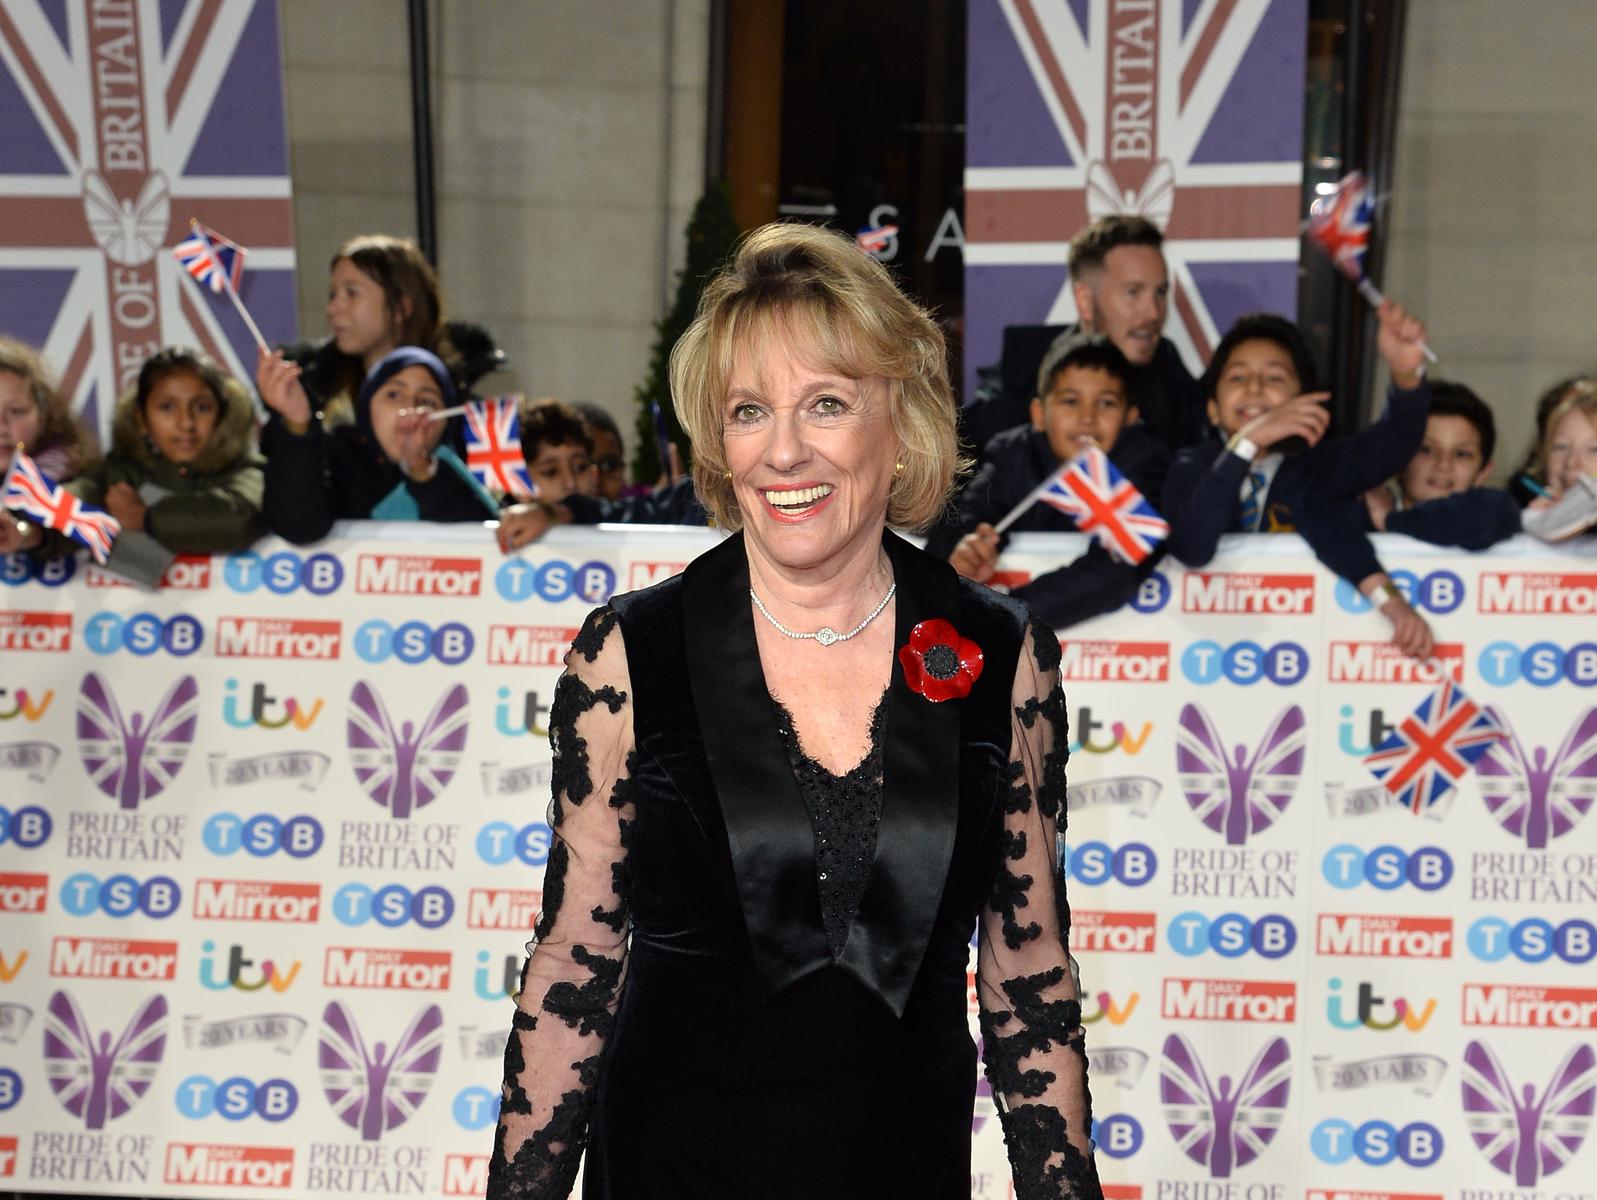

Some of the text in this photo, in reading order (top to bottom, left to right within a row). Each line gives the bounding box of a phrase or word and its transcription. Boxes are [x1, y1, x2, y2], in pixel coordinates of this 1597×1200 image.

[1111, 0, 1155, 161] BRITAI
[114, 266, 156, 328] OF
[4, 553, 67, 582] SB
[235, 558, 337, 590] TSB
[358, 556, 479, 595] Mirror
[505, 566, 608, 597] TSB
[1186, 574, 1312, 613] Mirror
[1482, 575, 1597, 612] Mirro
[0, 625, 70, 650] rror
[96, 620, 196, 651] TSB
[220, 619, 339, 658] Mirror
[365, 627, 466, 660] TSB
[491, 629, 572, 663] Mirr
[1192, 649, 1300, 680] TSB
[1332, 645, 1461, 681] Mirror
[1490, 650, 1597, 682] TSB
[223, 677, 326, 732] itv
[495, 686, 549, 737] it
[1068, 707, 1154, 755] tv
[1338, 704, 1396, 757] it
[69, 811, 141, 837] PRIDE
[150, 814, 188, 838] OF
[214, 820, 317, 846] TSB
[340, 820, 460, 847] PRIDE OF
[66, 834, 183, 861] BRITAIN
[338, 845, 455, 870] BRITAIN
[488, 829, 549, 857] TS
[1081, 849, 1149, 881] SB
[1172, 847, 1299, 873] PRIDE OF
[1334, 853, 1445, 885] TSB
[1471, 852, 1556, 876] PRIDE
[72, 880, 173, 912] TSB
[1171, 871, 1297, 899] BRITAIN
[1471, 876, 1597, 903] BRITAIN
[197, 881, 318, 922] Mirror
[344, 890, 446, 922] TSB
[1069, 923, 1154, 950] irror
[1179, 920, 1288, 952] TSB
[1320, 916, 1450, 956] Mirror
[1481, 925, 1591, 957] TSB
[54, 938, 174, 979] Mirror
[199, 940, 301, 993] itv
[327, 949, 447, 989] Mirror
[474, 950, 521, 1001] it
[1166, 979, 1293, 1021] Mirror
[1327, 976, 1438, 1033] itv
[1466, 986, 1597, 1026] Mirror
[187, 1083, 290, 1115] TSB
[33, 1131, 154, 1157] PRIDE OF
[309, 1143, 430, 1169] PRIDE OF
[1322, 1127, 1434, 1160] TSB
[29, 1155, 150, 1183] BRITAIN
[167, 1145, 290, 1186] Mirror
[306, 1166, 428, 1194] BRITAIN
